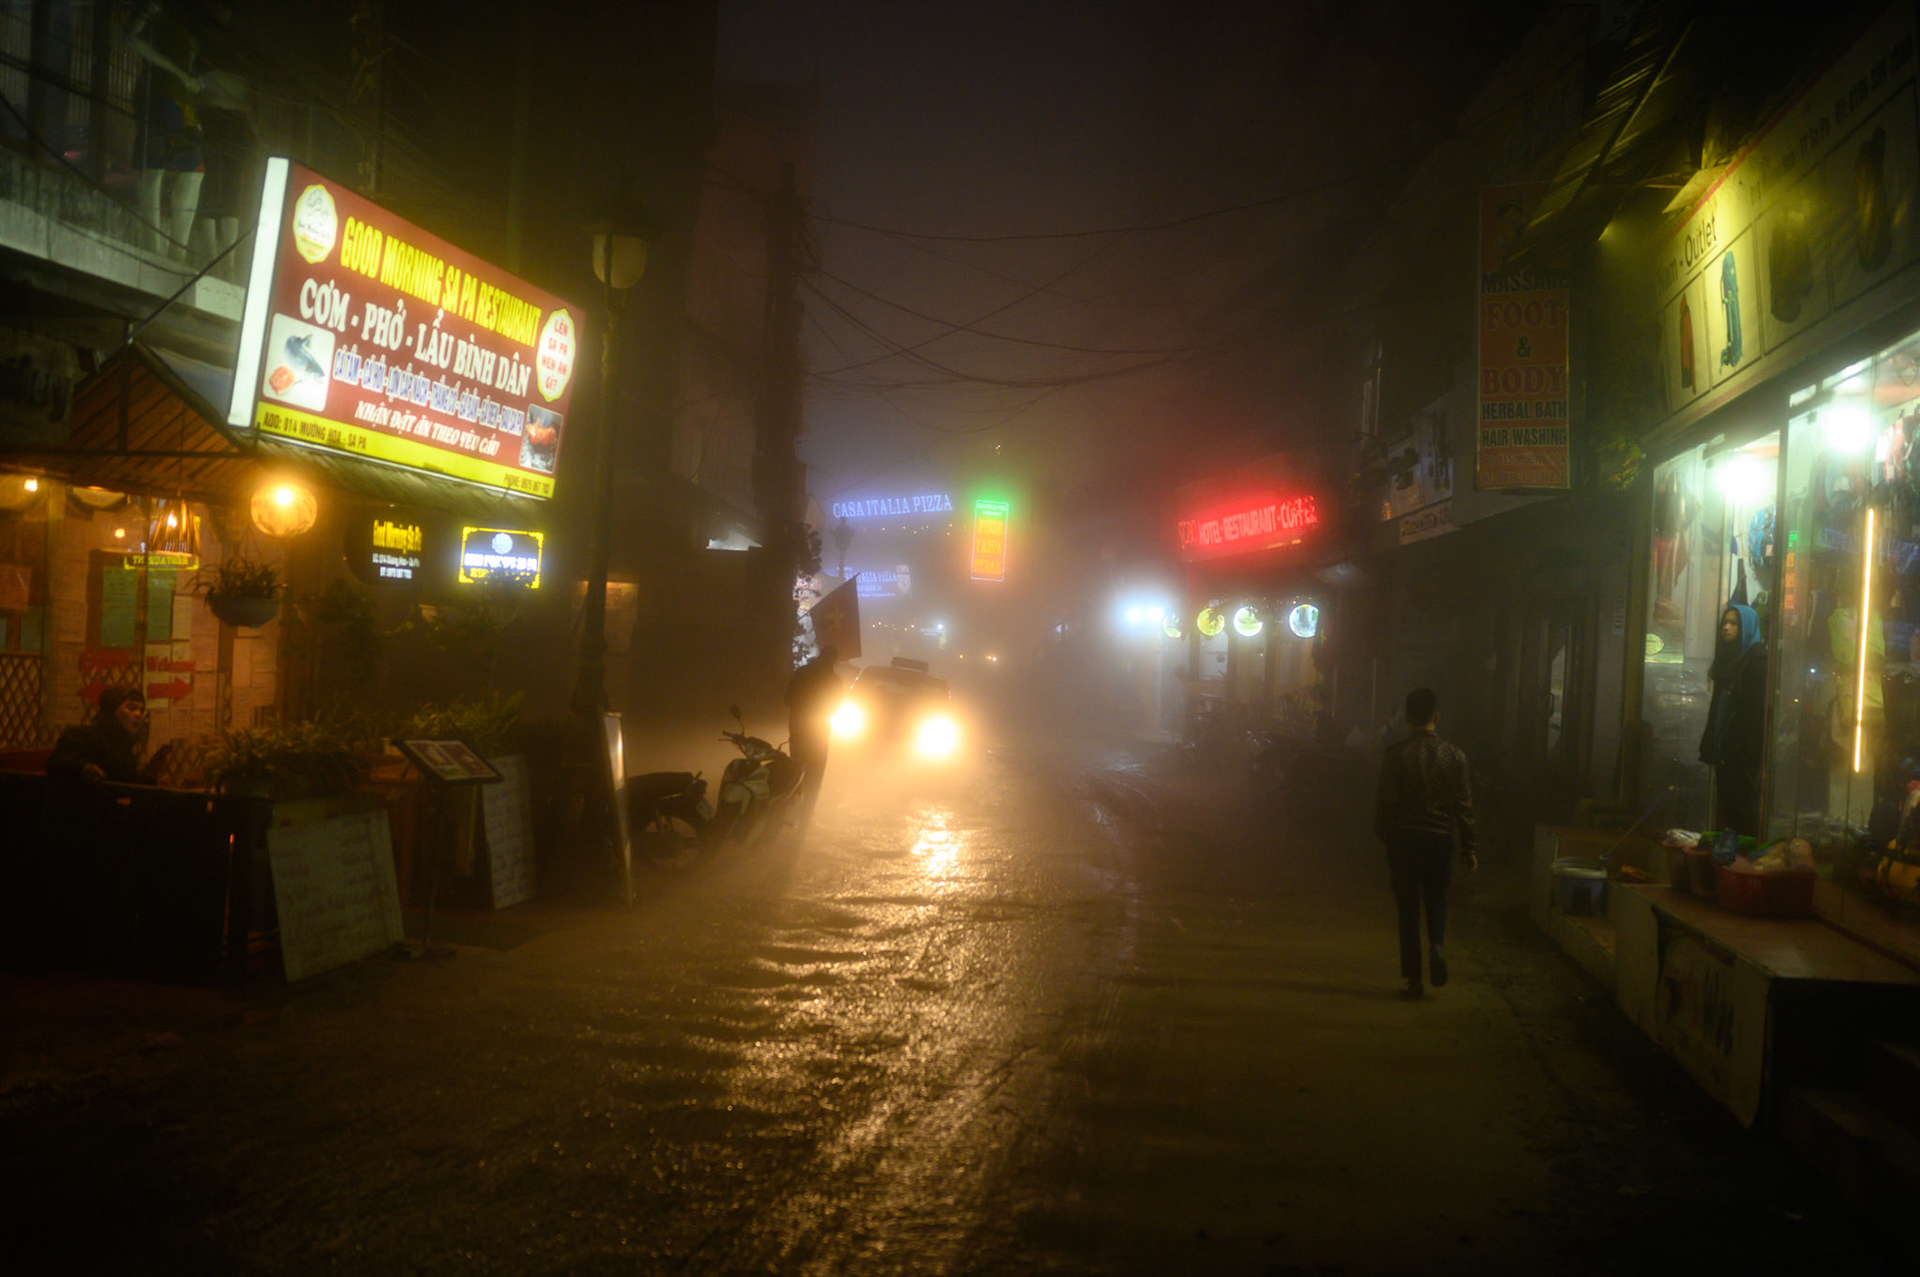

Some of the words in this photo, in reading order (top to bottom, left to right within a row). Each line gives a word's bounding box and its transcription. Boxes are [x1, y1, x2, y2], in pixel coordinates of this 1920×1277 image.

[1685, 212, 1716, 267] Outlet
[340, 216, 382, 278] GOOD
[380, 235, 444, 306] MORNING
[442, 264, 461, 314] SA
[458, 273, 478, 321] PA
[474, 282, 542, 348] RESTAURANT
[1481, 272, 1569, 293] MASSAGE
[1485, 301, 1561, 330] FOOT
[300, 278, 350, 332] CƠM
[362, 299, 407, 351] PHỞ
[414, 308, 454, 369] LẨU
[453, 334, 497, 386] BÌNH
[495, 352, 531, 397] DÂN
[1517, 336, 1532, 358] &
[1482, 366, 1566, 395] BODY
[354, 401, 392, 428] NHẬN
[390, 410, 417, 434] ĐẶT
[432, 423, 460, 445] THEO
[1482, 402, 1530, 420] HERBAL
[1535, 401, 1567, 418] BATH
[358, 436, 367, 450] PA
[1482, 429, 1508, 446] HAIR
[1512, 428, 1567, 446] WASHING
[833, 502, 865, 519] CASA
[866, 498, 910, 517] ITALIA
[912, 494, 953, 512] PIZZA
[1200, 520, 1222, 545] HOTEL
[1223, 505, 1277, 541] RESTAURANT
